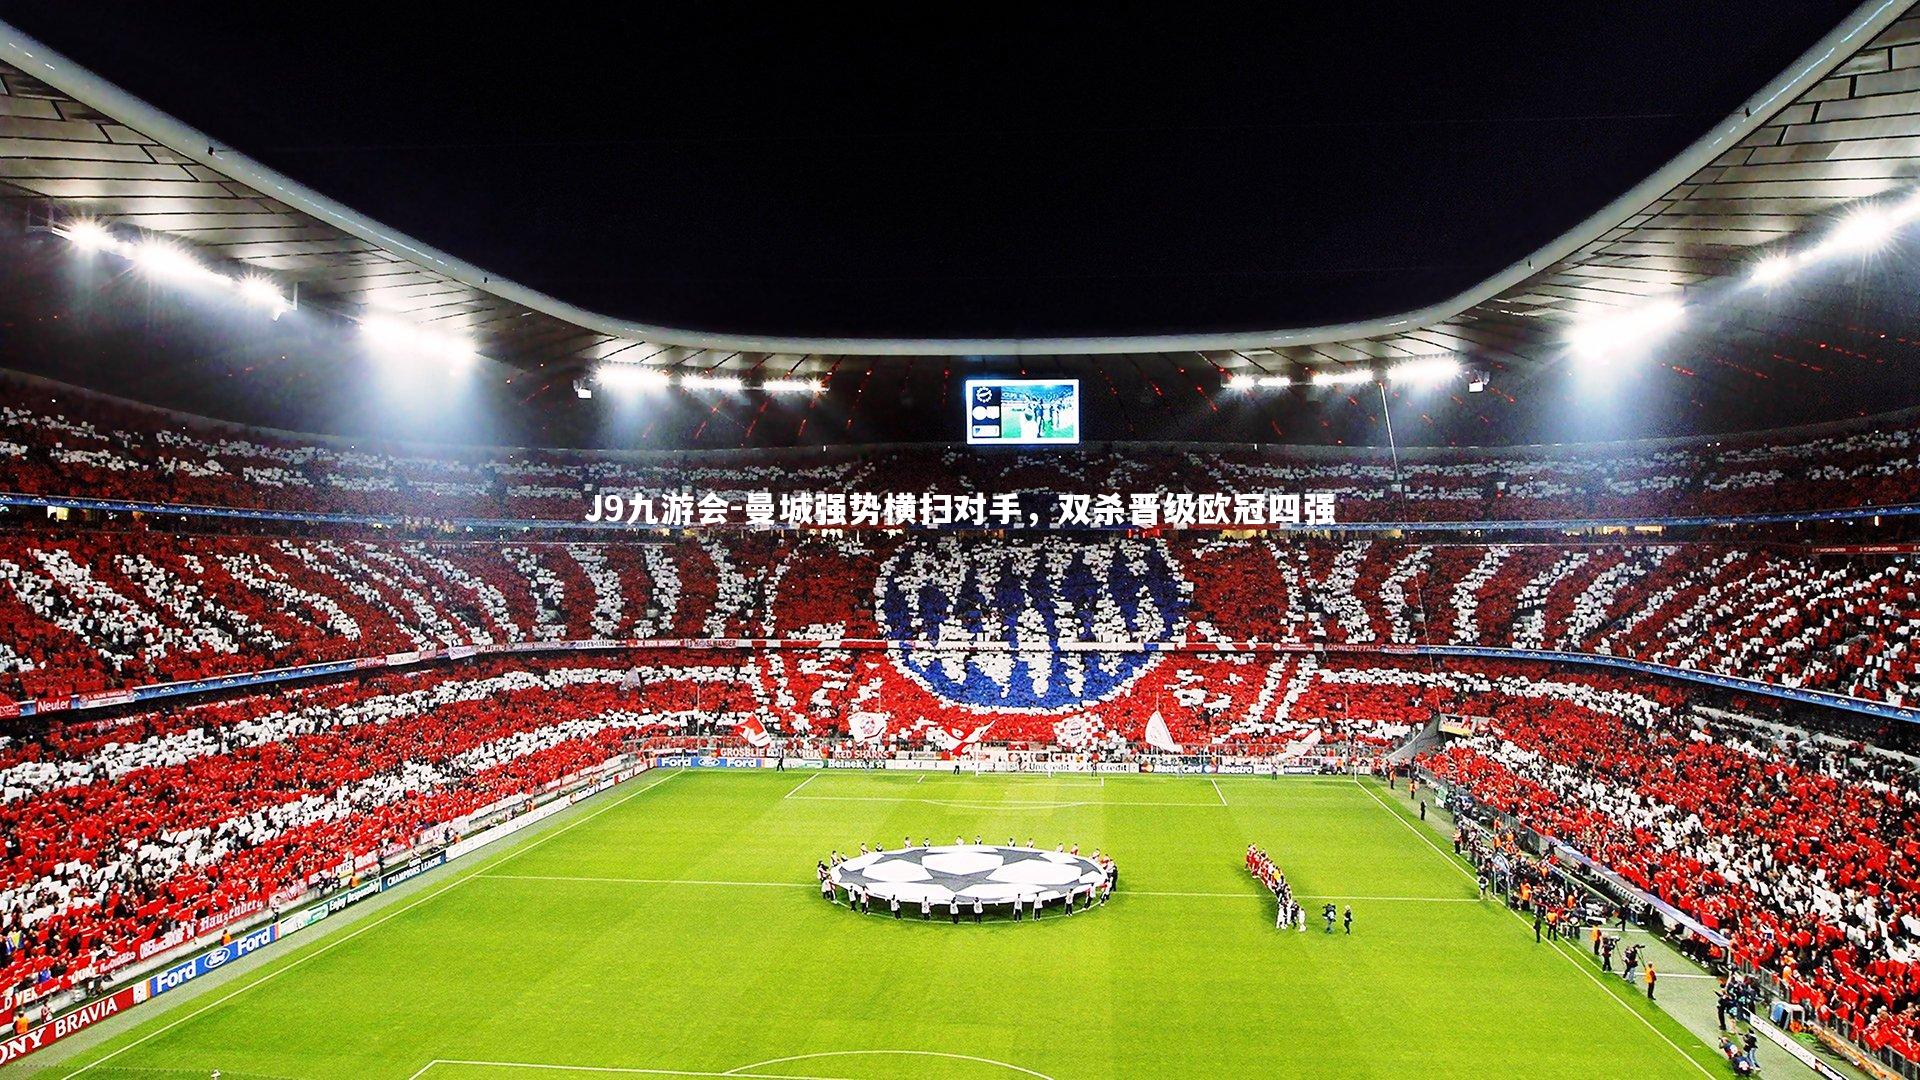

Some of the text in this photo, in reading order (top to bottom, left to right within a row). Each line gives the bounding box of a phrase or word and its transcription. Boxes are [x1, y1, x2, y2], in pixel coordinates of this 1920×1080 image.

[37, 700, 70, 713] Neuler
[661, 757, 692, 767] Ford
[727, 758, 756, 767] Ford
[828, 759, 875, 769] Heinekn
[238, 929, 270, 956] Ford
[157, 960, 196, 993] Ford
[55, 997, 118, 1039] BRAVIA
